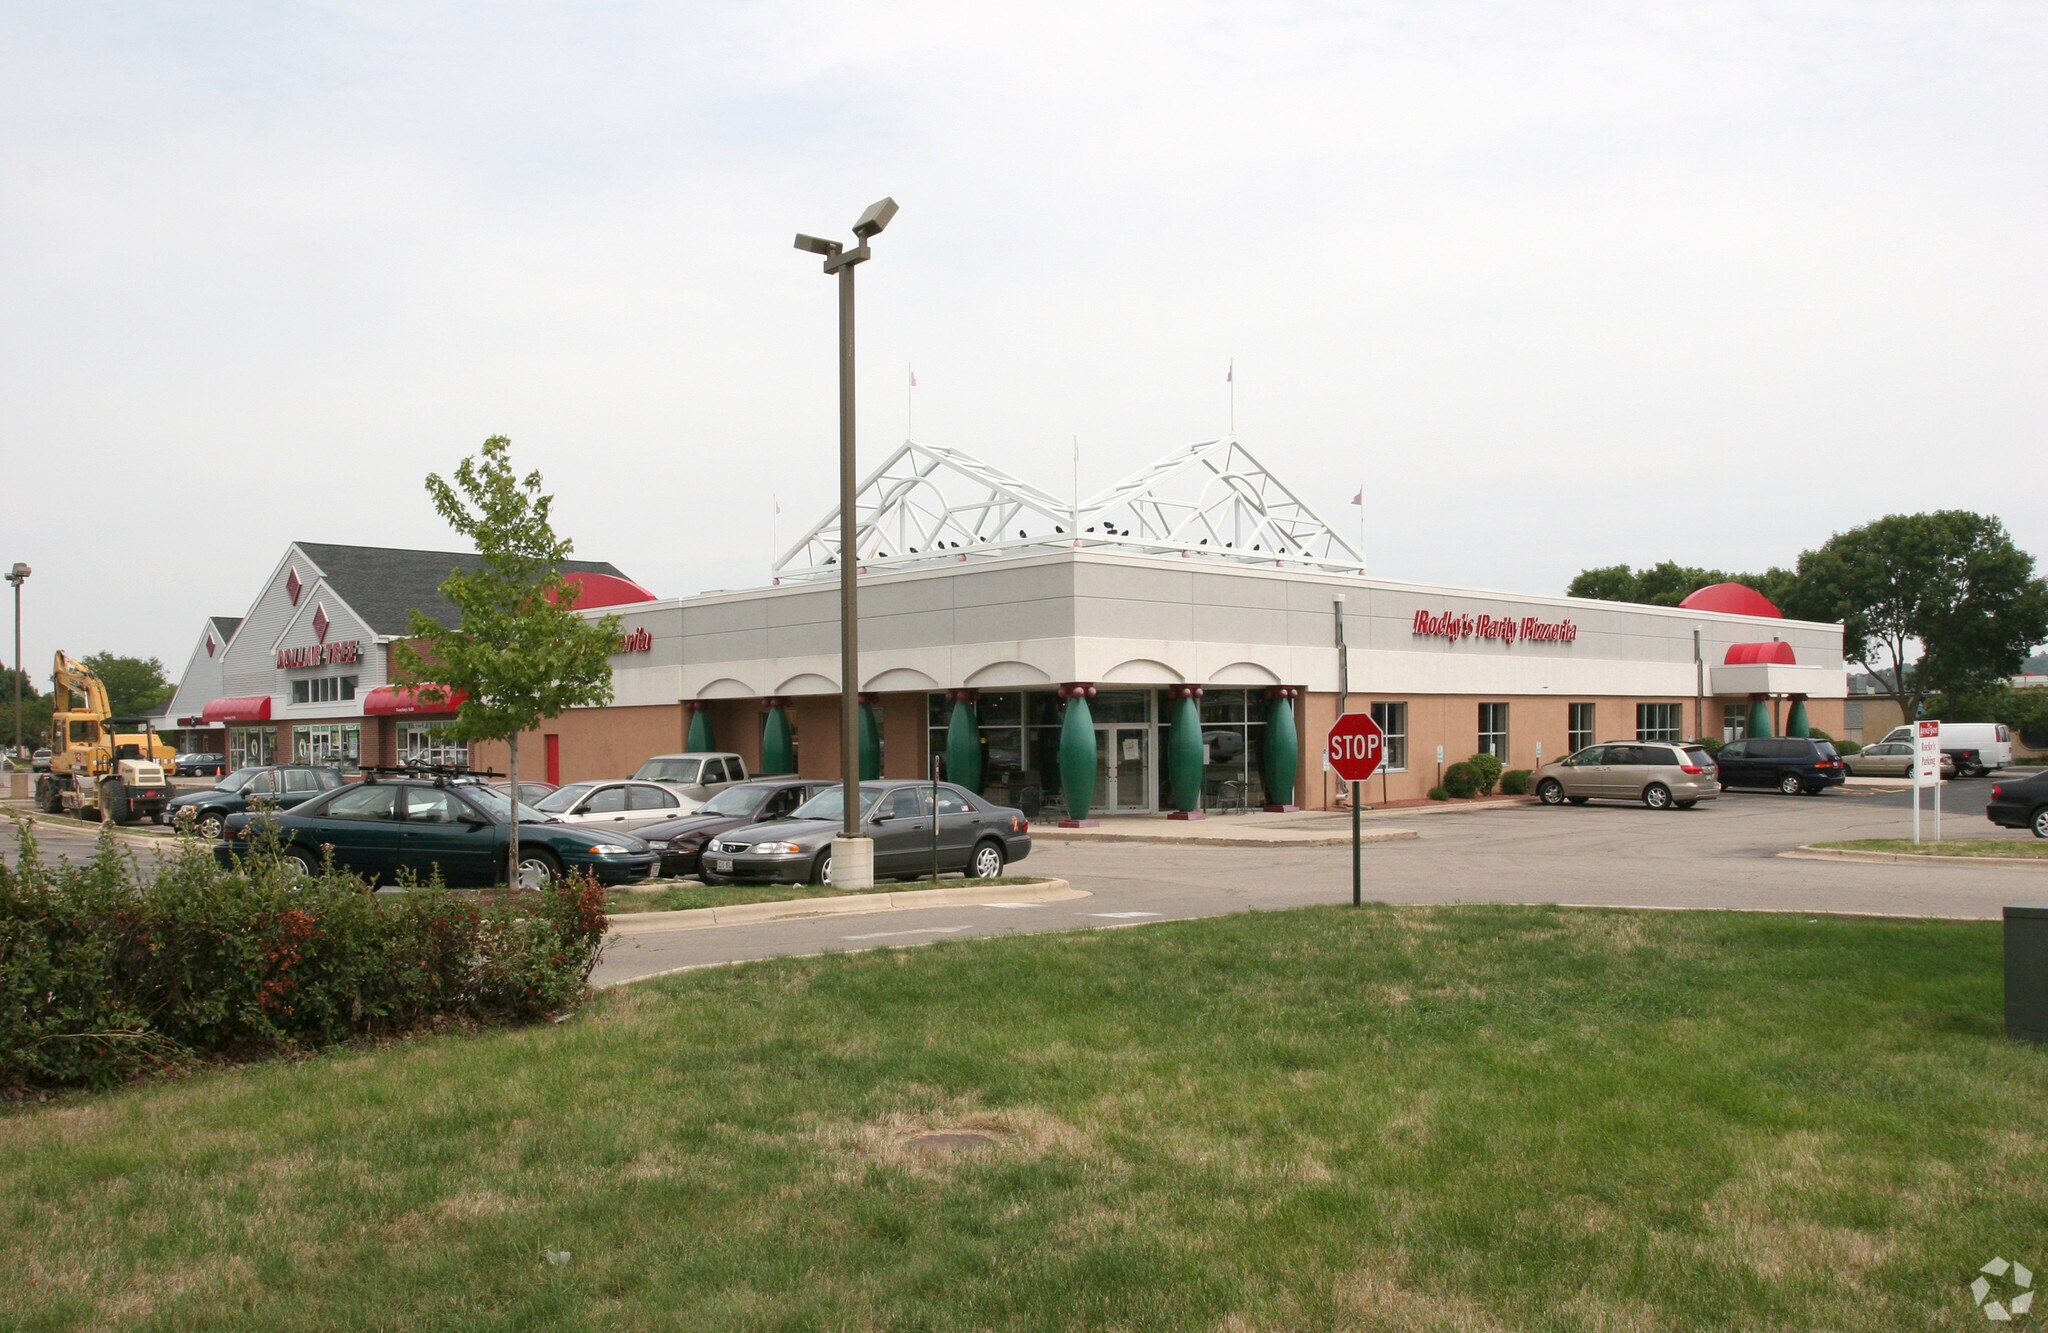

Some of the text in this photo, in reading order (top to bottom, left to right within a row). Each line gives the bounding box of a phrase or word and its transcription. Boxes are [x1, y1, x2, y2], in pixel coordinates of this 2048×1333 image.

[1412, 609, 1577, 643] Rocky's Party Pizzeria
[276, 640, 359, 669] DOLLAR TREE
[1331, 734, 1379, 760] STOP
[1921, 756, 1936, 767] Parking
